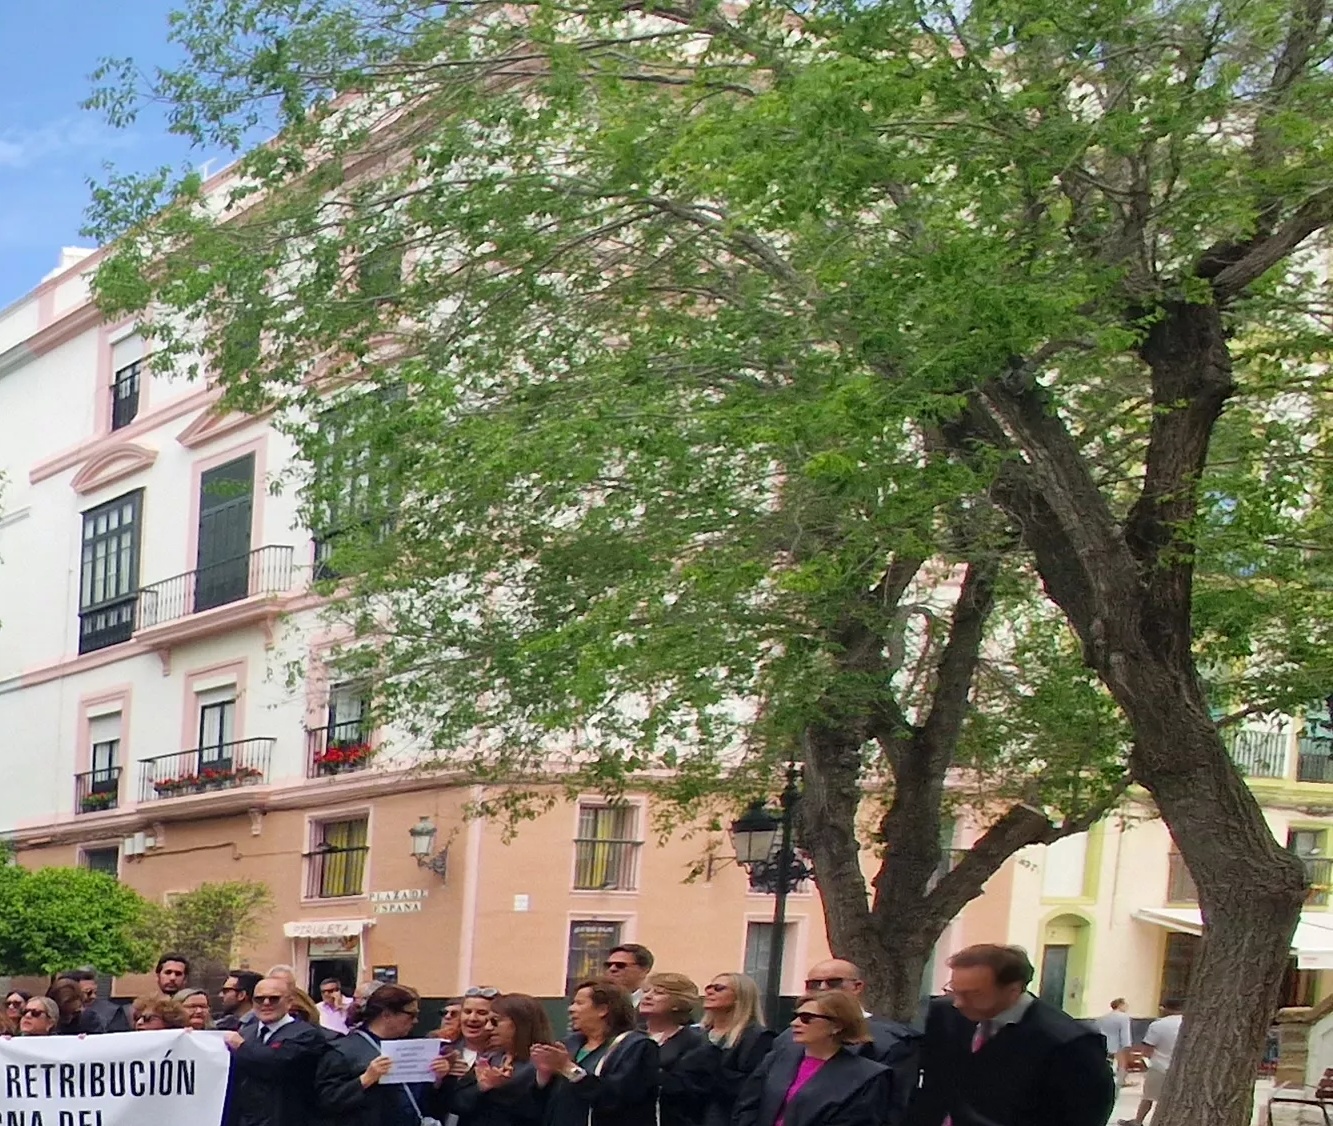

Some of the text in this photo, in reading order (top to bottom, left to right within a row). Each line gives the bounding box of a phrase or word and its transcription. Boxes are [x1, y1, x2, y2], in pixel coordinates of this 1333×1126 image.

[369, 888, 427, 901] PLAZA DE
[292, 923, 349, 935] PIRULETA
[7, 1050, 194, 1098] RETRIBUCIÓN
